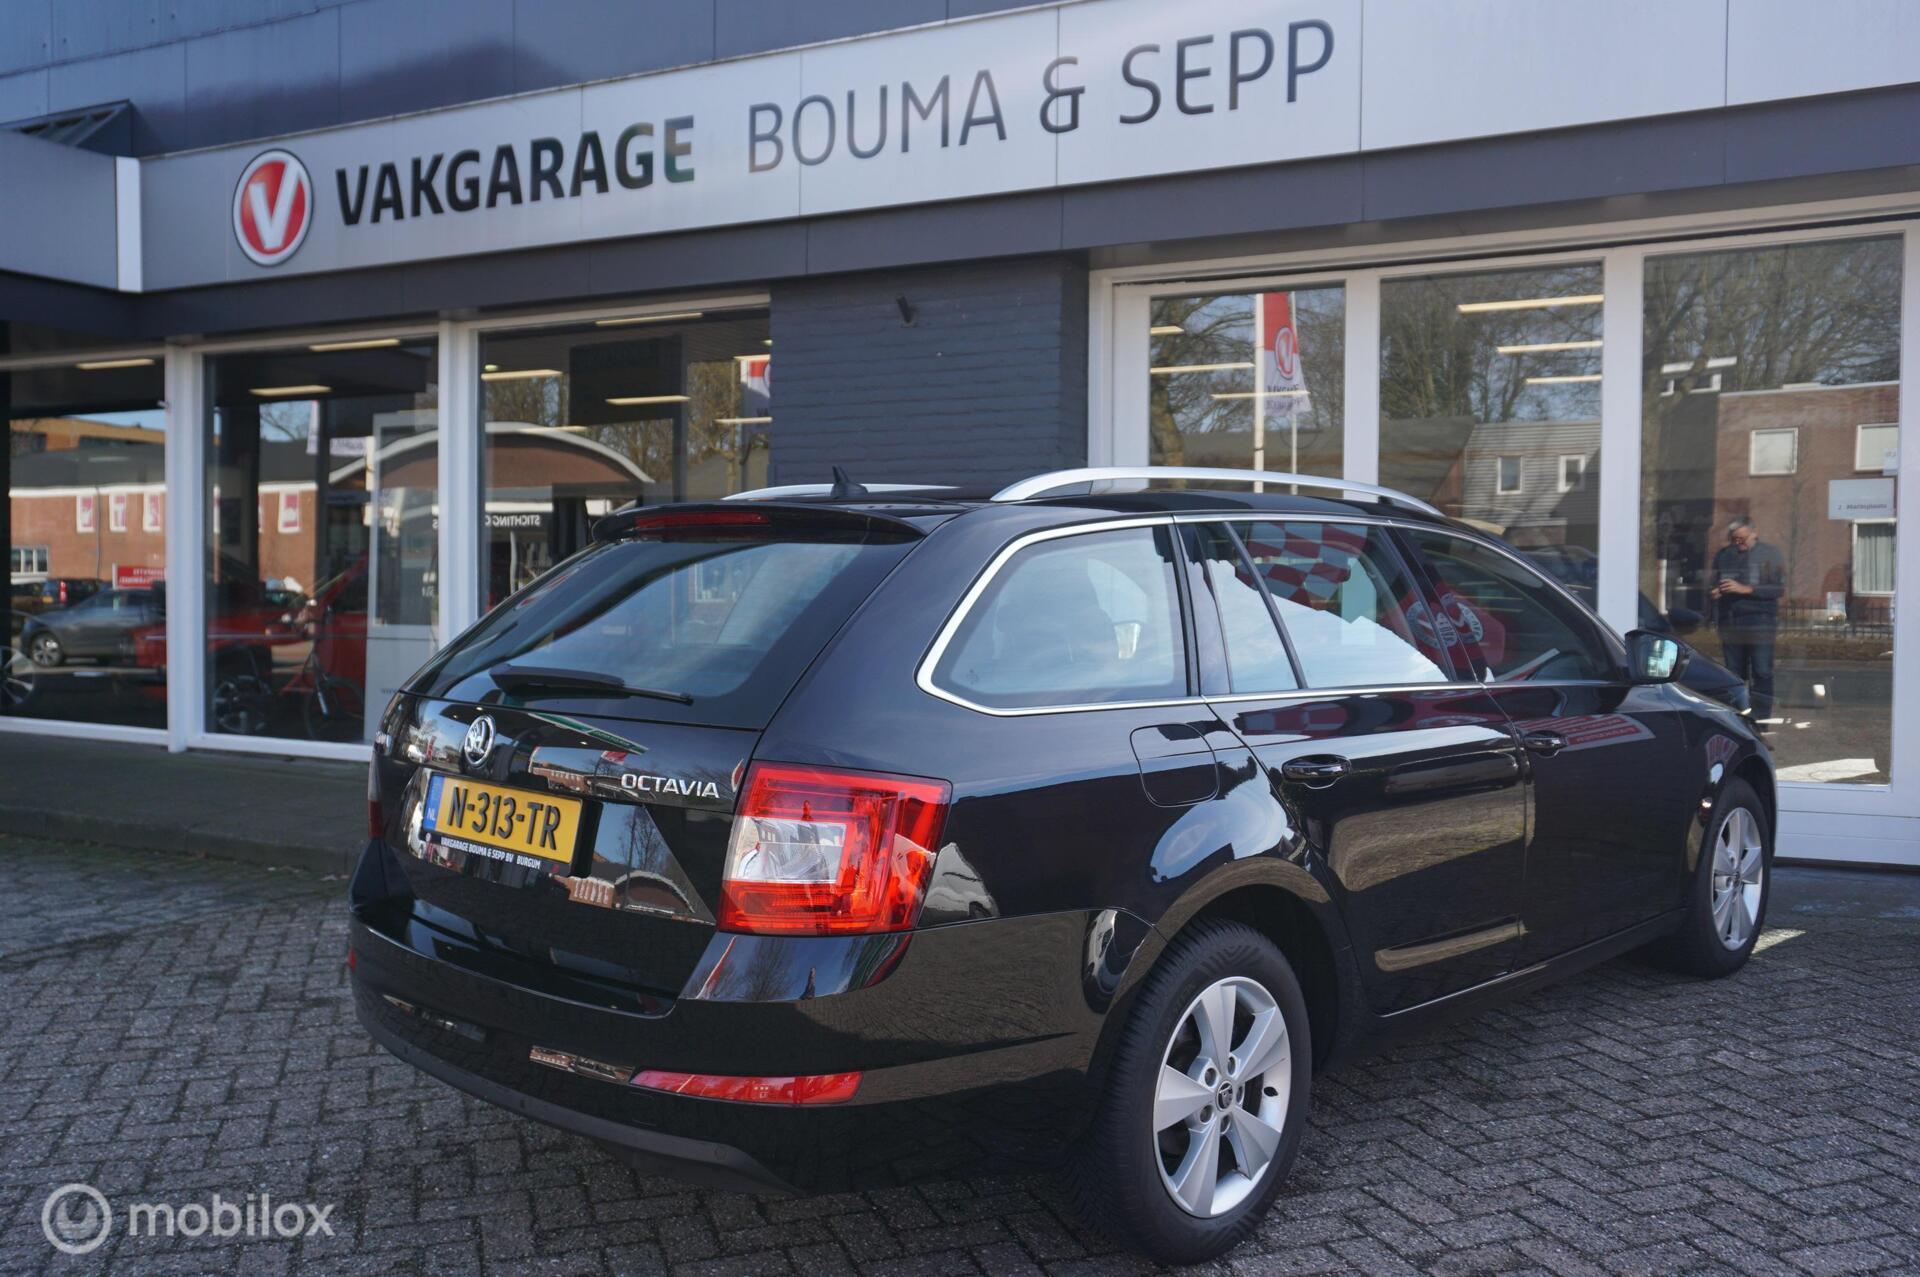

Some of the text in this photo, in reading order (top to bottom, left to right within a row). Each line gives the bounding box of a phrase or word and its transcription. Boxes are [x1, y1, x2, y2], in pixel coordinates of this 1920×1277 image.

[336, 19, 1335, 226] VAKGARAGE BOUMA & SEPP
[621, 773, 720, 798] OCTAVIA
[427, 808, 437, 821] NL
[447, 786, 561, 851] N-313-TR
[468, 843, 487, 857] BOUMA
[491, 848, 506, 861] SEPP
[516, 854, 541, 869] BURGUM
